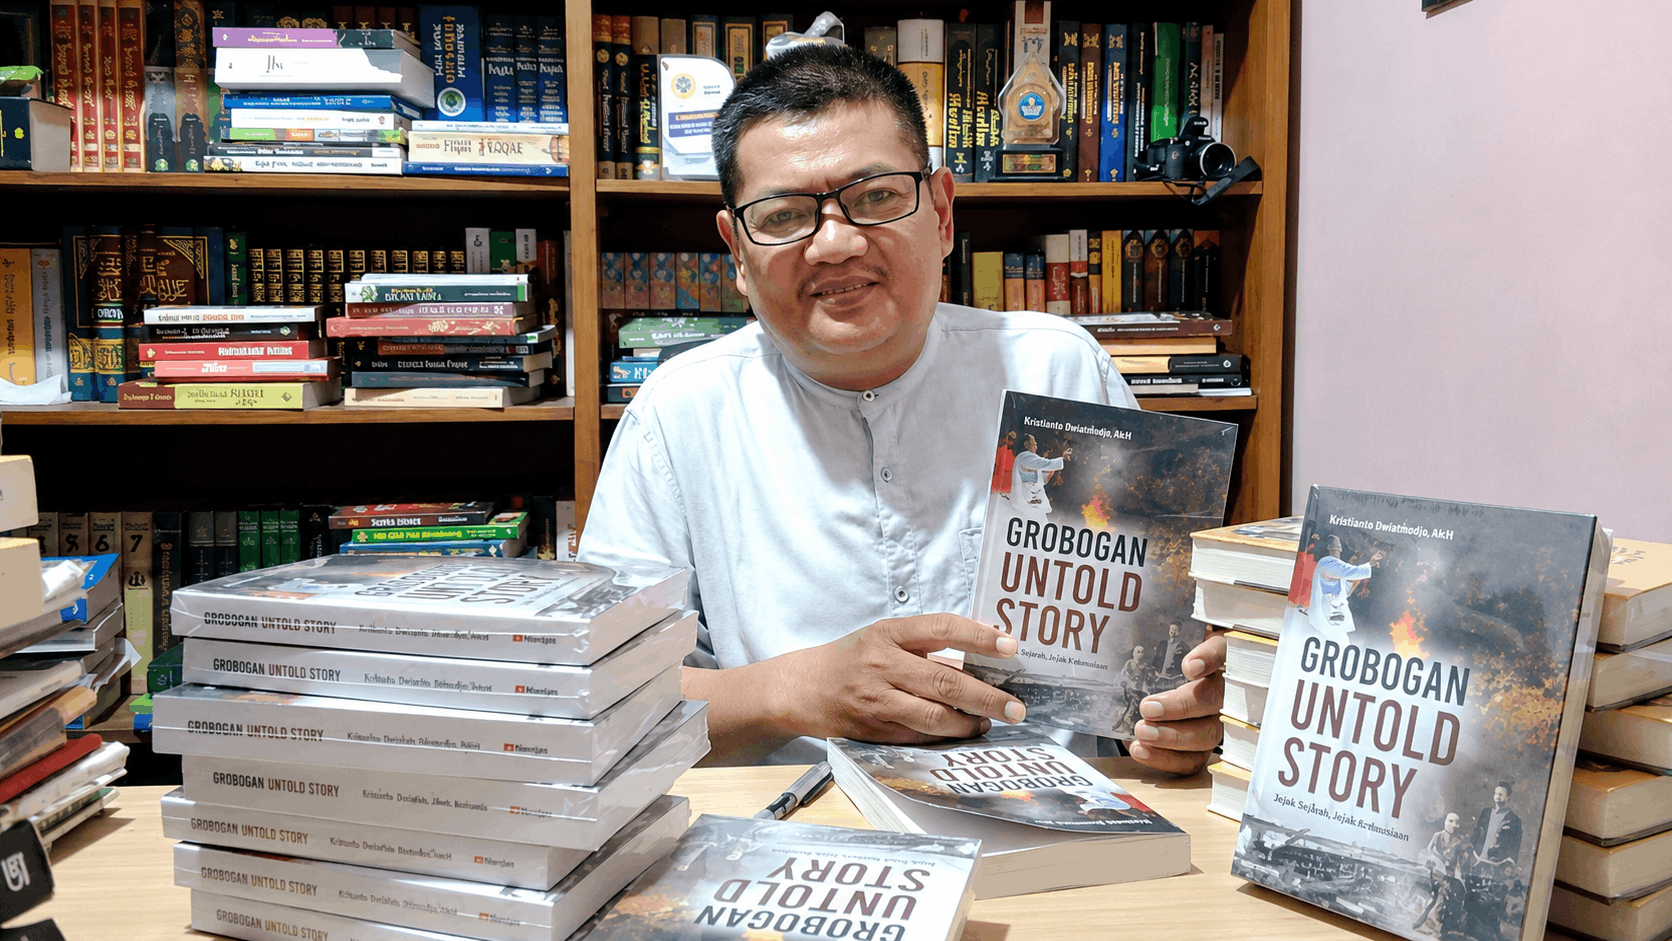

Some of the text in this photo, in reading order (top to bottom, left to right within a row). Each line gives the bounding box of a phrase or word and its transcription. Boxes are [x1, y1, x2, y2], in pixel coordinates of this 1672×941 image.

[1024, 416, 1063, 430] Kristianto
[1329, 514, 1373, 530] Kristianto
[1375, 521, 1430, 539] Dwiatmodjo,
[129, 534, 143, 553] 7
[1006, 517, 1148, 567] GROBOGAN
[460, 574, 559, 604] STORY
[1000, 552, 1142, 612] UNTOLD
[204, 611, 337, 634] GROBOGAN UNTOLD STORY
[994, 598, 1110, 654] STORY
[213, 658, 341, 682] GROBOGAN UNTOLD STORY
[1300, 636, 1471, 707] GROBOGAN
[187, 720, 324, 742] GROBOGAN UNTOLD STORY
[1290, 679, 1461, 767] UNTOLD
[929, 760, 1078, 782] UNTOLD
[940, 747, 1056, 767] STORY
[213, 771, 340, 798] GROBOGAN UNTOLD STORY
[945, 775, 1094, 795] GROBOGAN
[1278, 736, 1418, 819] STORY
[190, 817, 309, 845] GROBOGAN UNTOLD STORY
[1333, 811, 1356, 826] Jejak
[201, 866, 318, 897] GROBOGAN UNTOLD STORY
[766, 857, 931, 892] STORY
[712, 878, 918, 921] UNTOLD
[216, 909, 329, 941] GROBOGAN UNTOLD STORY
[694, 904, 906, 941] GROBOGAN
